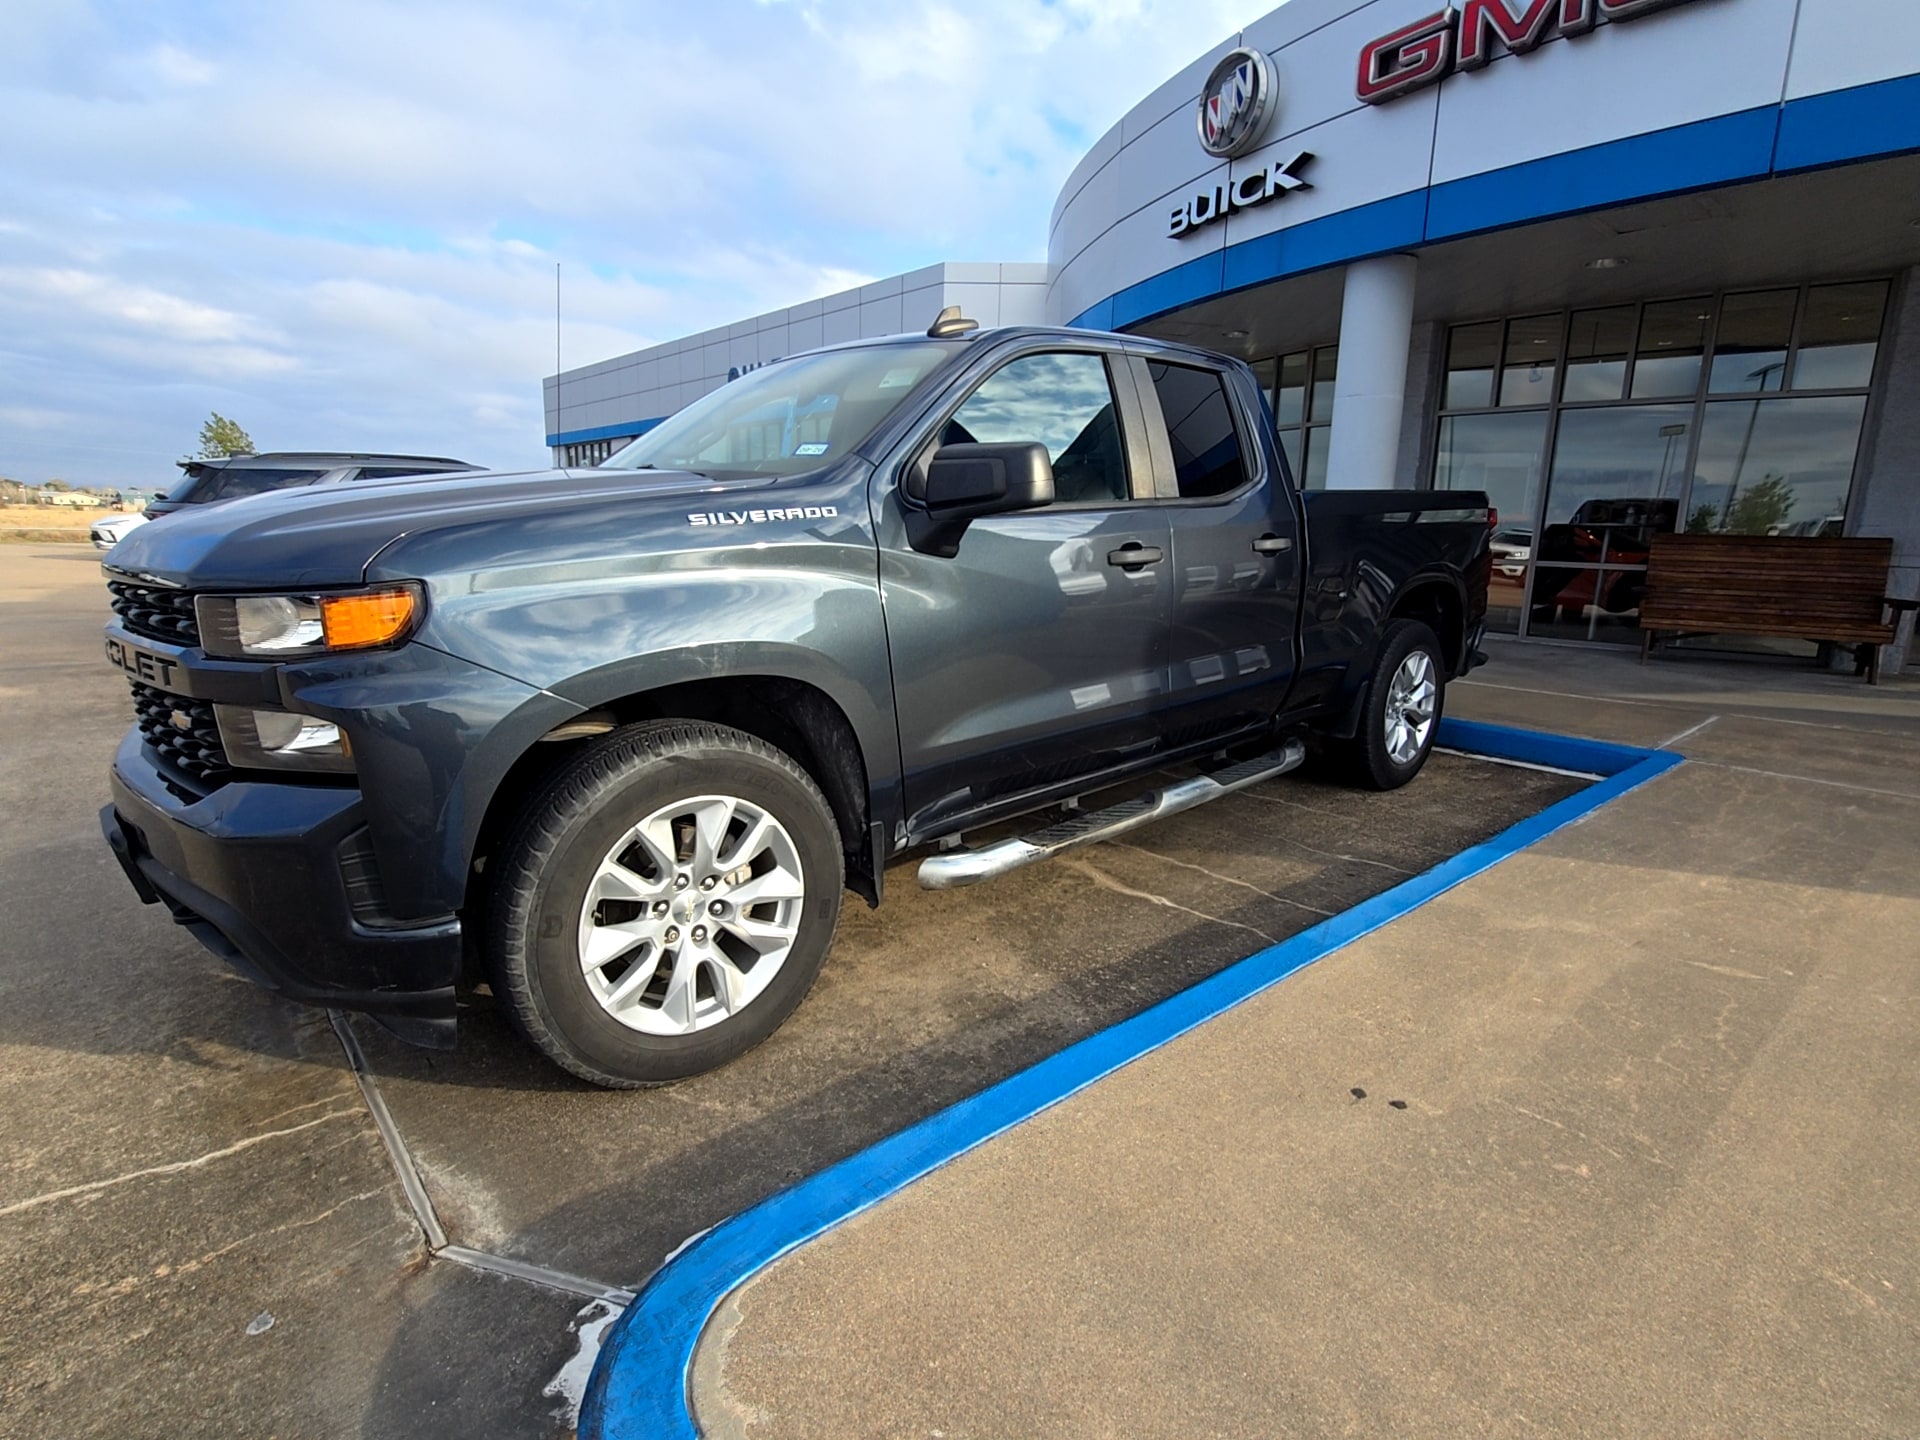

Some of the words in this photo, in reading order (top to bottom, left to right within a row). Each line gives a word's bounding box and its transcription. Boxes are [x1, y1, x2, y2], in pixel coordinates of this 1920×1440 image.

[1355, 0, 1704, 104] GM
[1167, 150, 1314, 239] BUICK
[687, 506, 838, 526] SILVERADO
